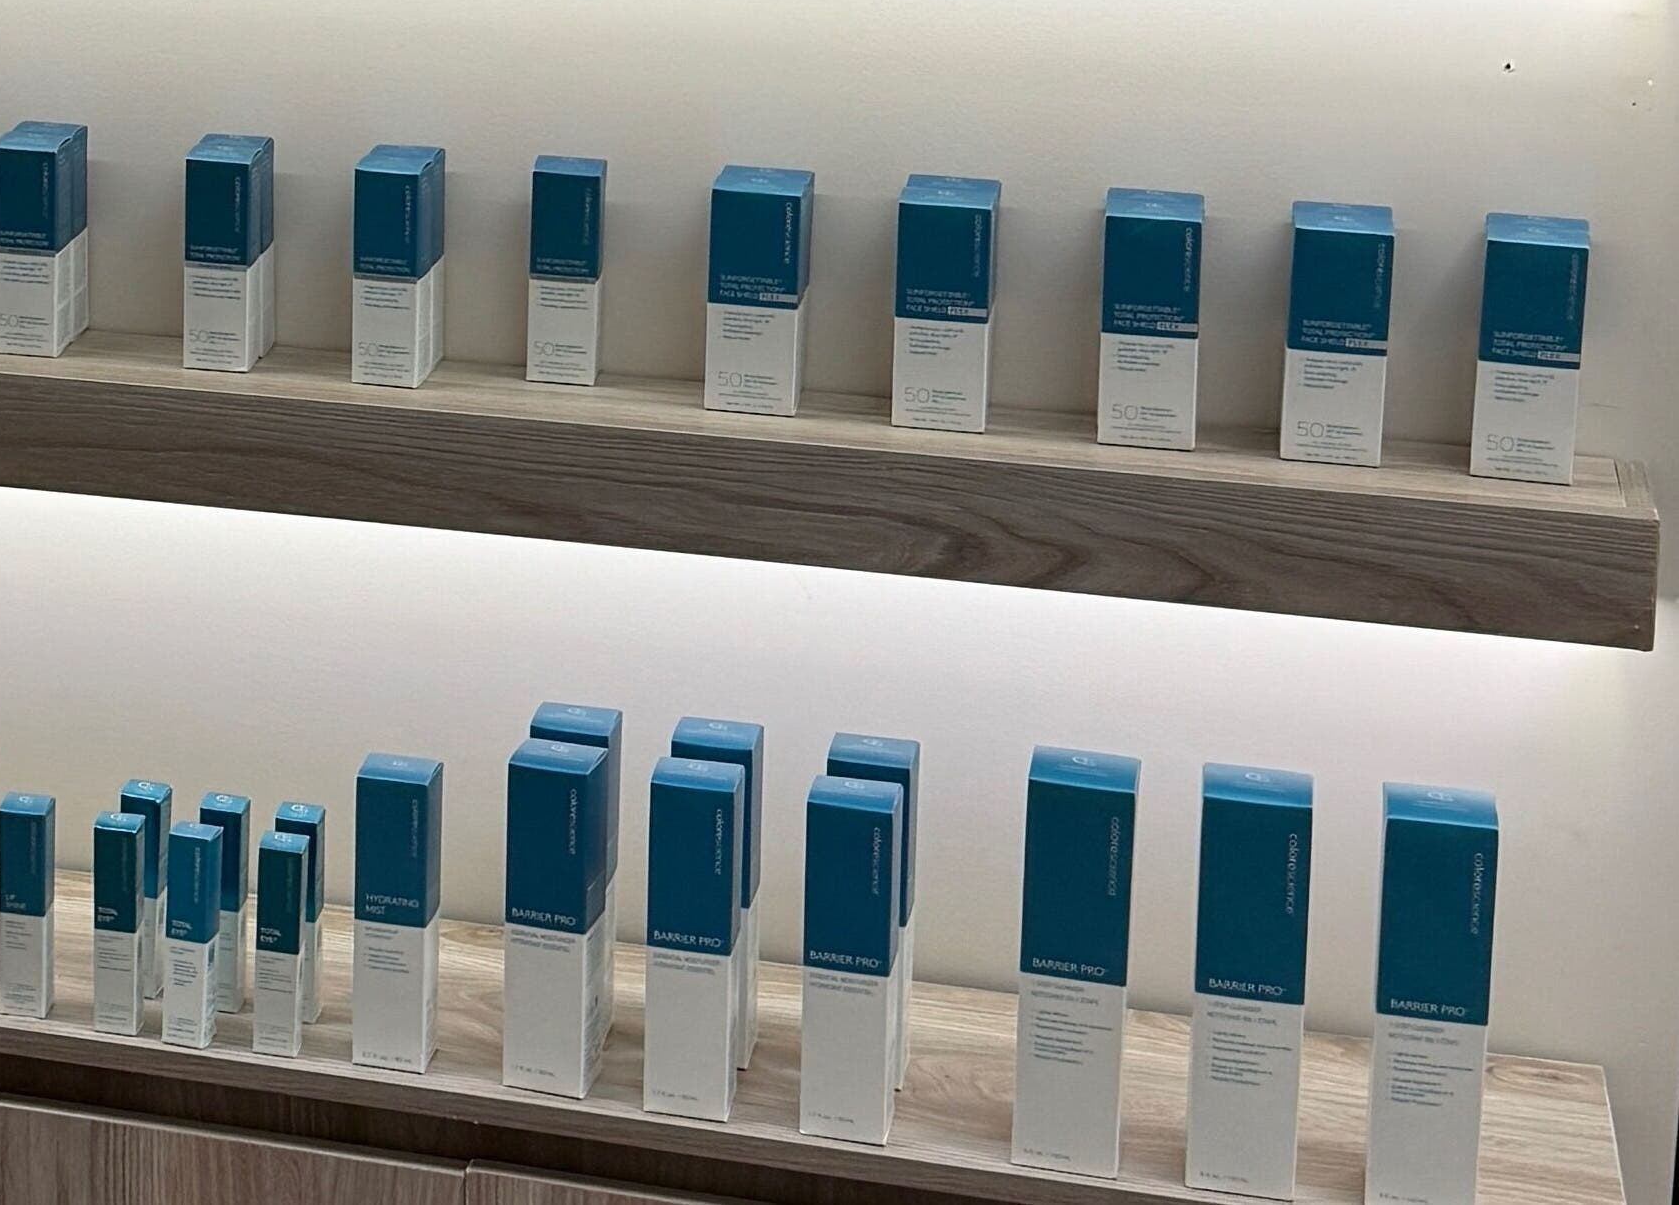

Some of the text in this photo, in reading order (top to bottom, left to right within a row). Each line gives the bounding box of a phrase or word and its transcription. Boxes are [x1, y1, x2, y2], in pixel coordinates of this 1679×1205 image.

[717, 371, 743, 388] 50
[904, 387, 930, 403] 50
[1111, 403, 1138, 421] 50
[1295, 420, 1324, 438] 50
[1486, 433, 1515, 452] 50
[365, 893, 419, 908] HYDRATING
[365, 905, 386, 916] MIST
[511, 907, 576, 927] BARRIER PRO
[653, 929, 721, 948] BARRIER PRO
[809, 949, 879, 969] BARRIER PRO
[1032, 957, 1105, 977] BARRIER PRO
[1208, 978, 1282, 996] BARRIER PRO
[1390, 998, 1466, 1018] BARRIER PRO
